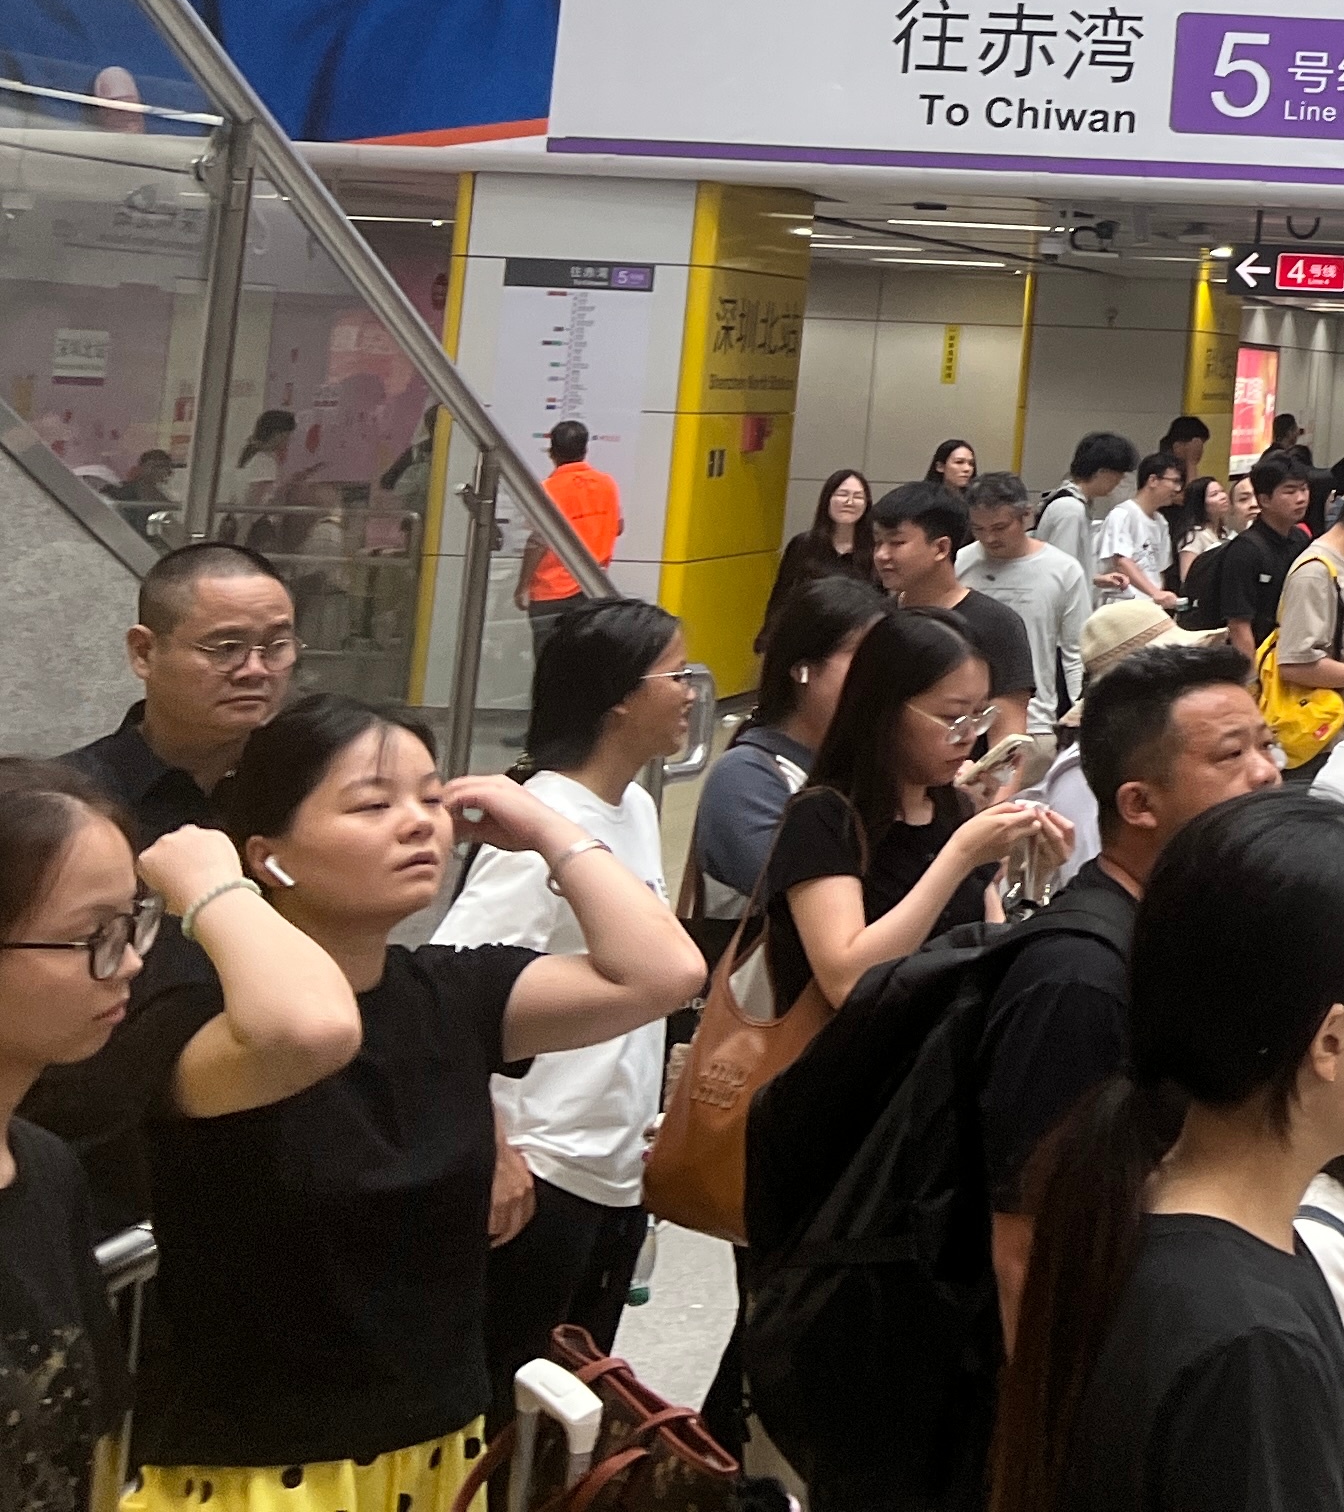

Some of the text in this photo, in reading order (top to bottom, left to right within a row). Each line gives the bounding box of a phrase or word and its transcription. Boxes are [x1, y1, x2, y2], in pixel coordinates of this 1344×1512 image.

[920, 94, 1137, 135] To Chiwan
[1284, 100, 1338, 123] Line
